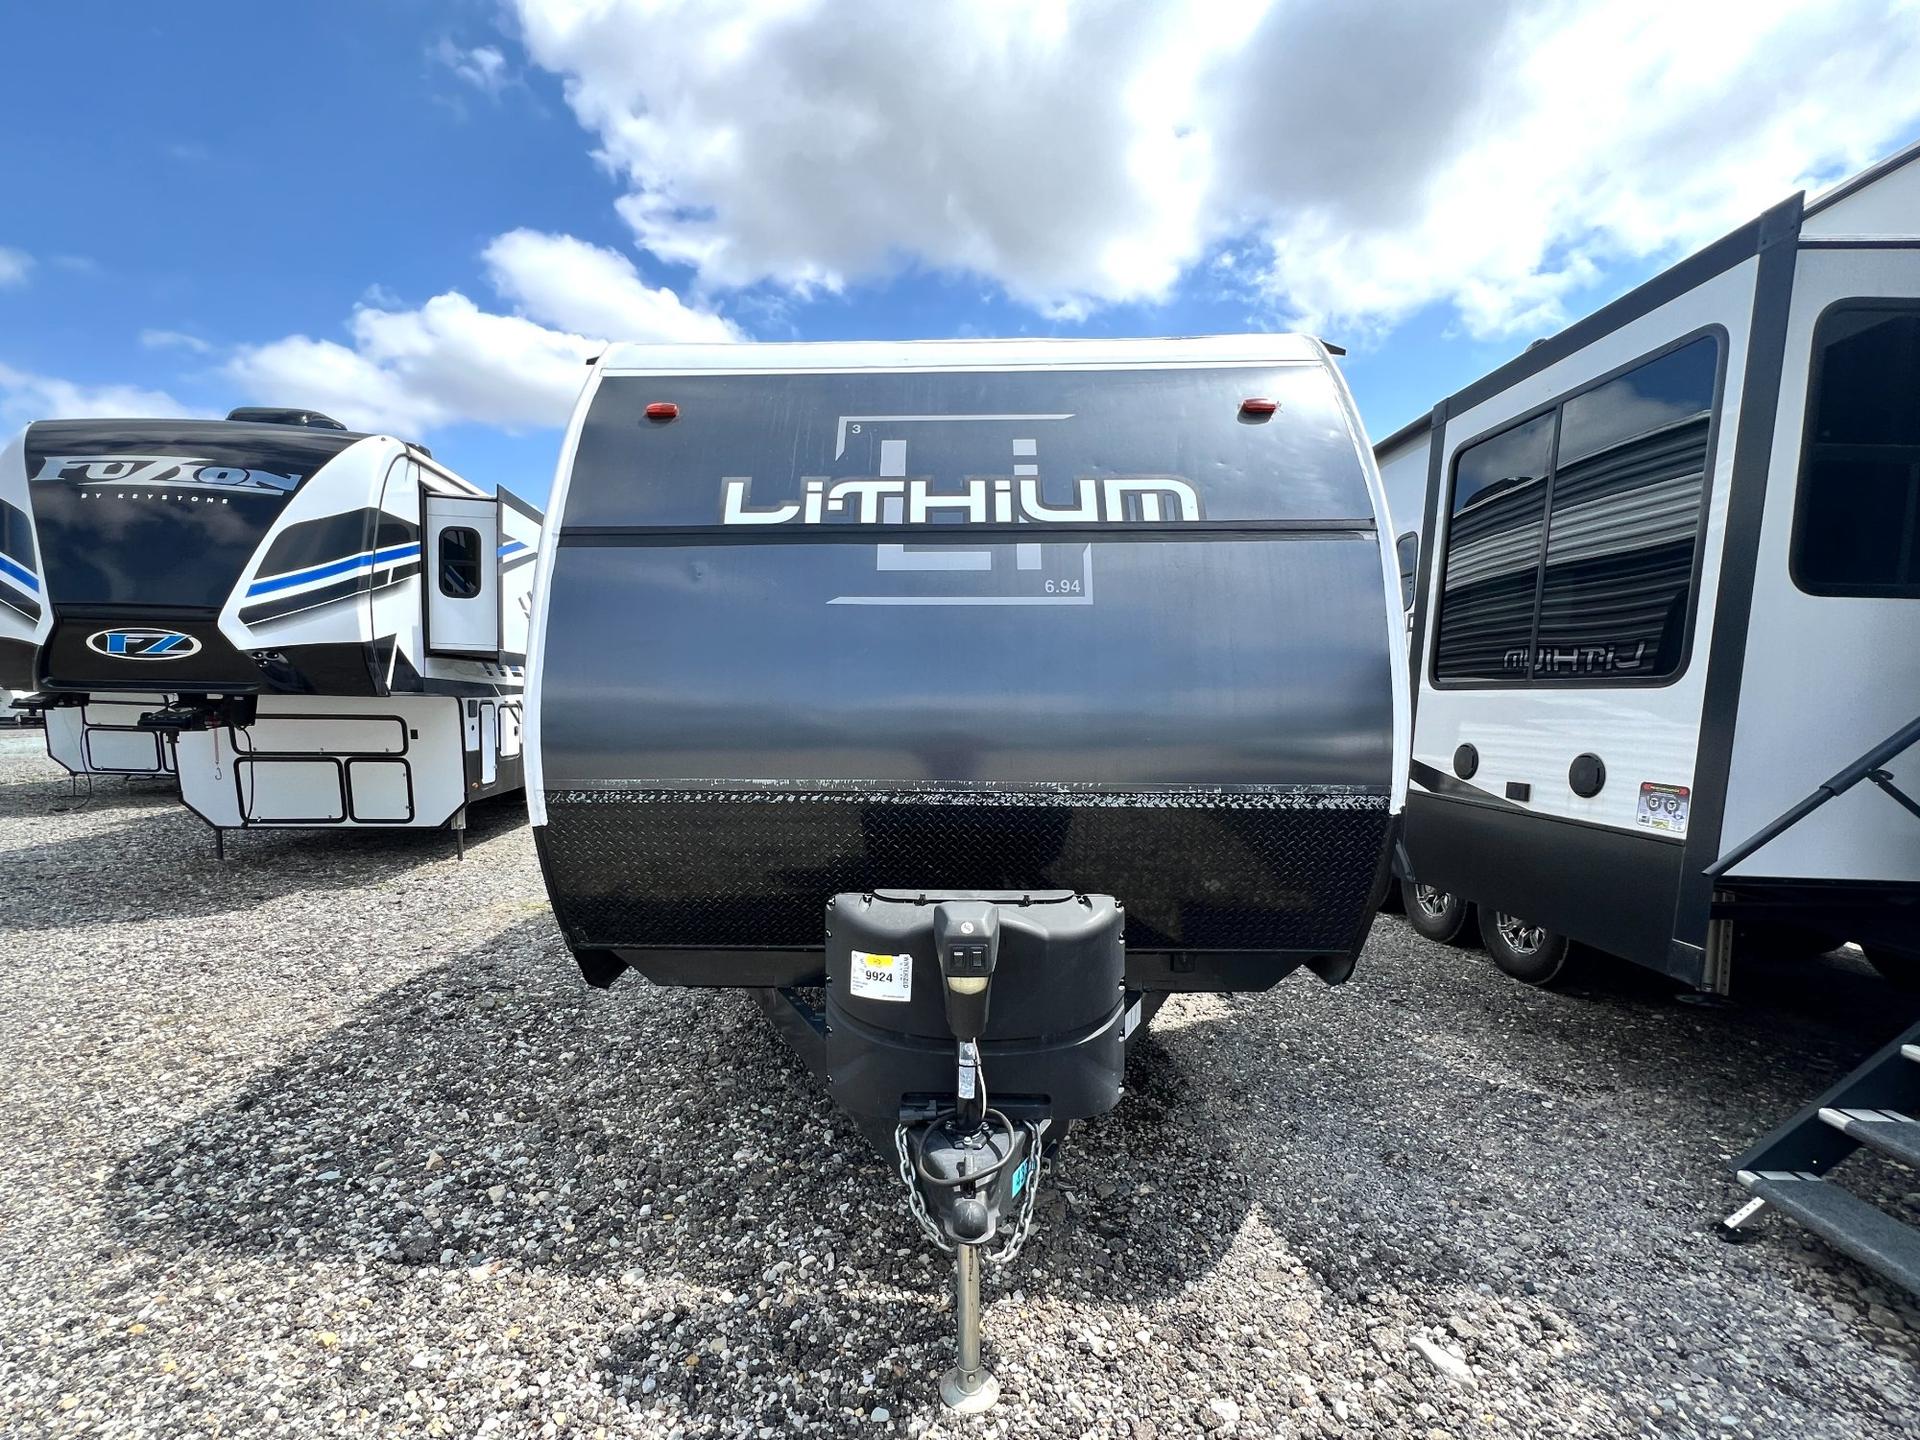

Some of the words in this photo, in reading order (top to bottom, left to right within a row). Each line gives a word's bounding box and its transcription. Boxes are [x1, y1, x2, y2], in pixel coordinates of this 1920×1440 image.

[852, 424, 861, 434] 3
[31, 455, 303, 496] FUZION
[117, 493, 229, 505] KEYSTONE
[1044, 579, 1081, 593] 6.94
[105, 633, 192, 655] FZ
[865, 969, 893, 983] 9924
